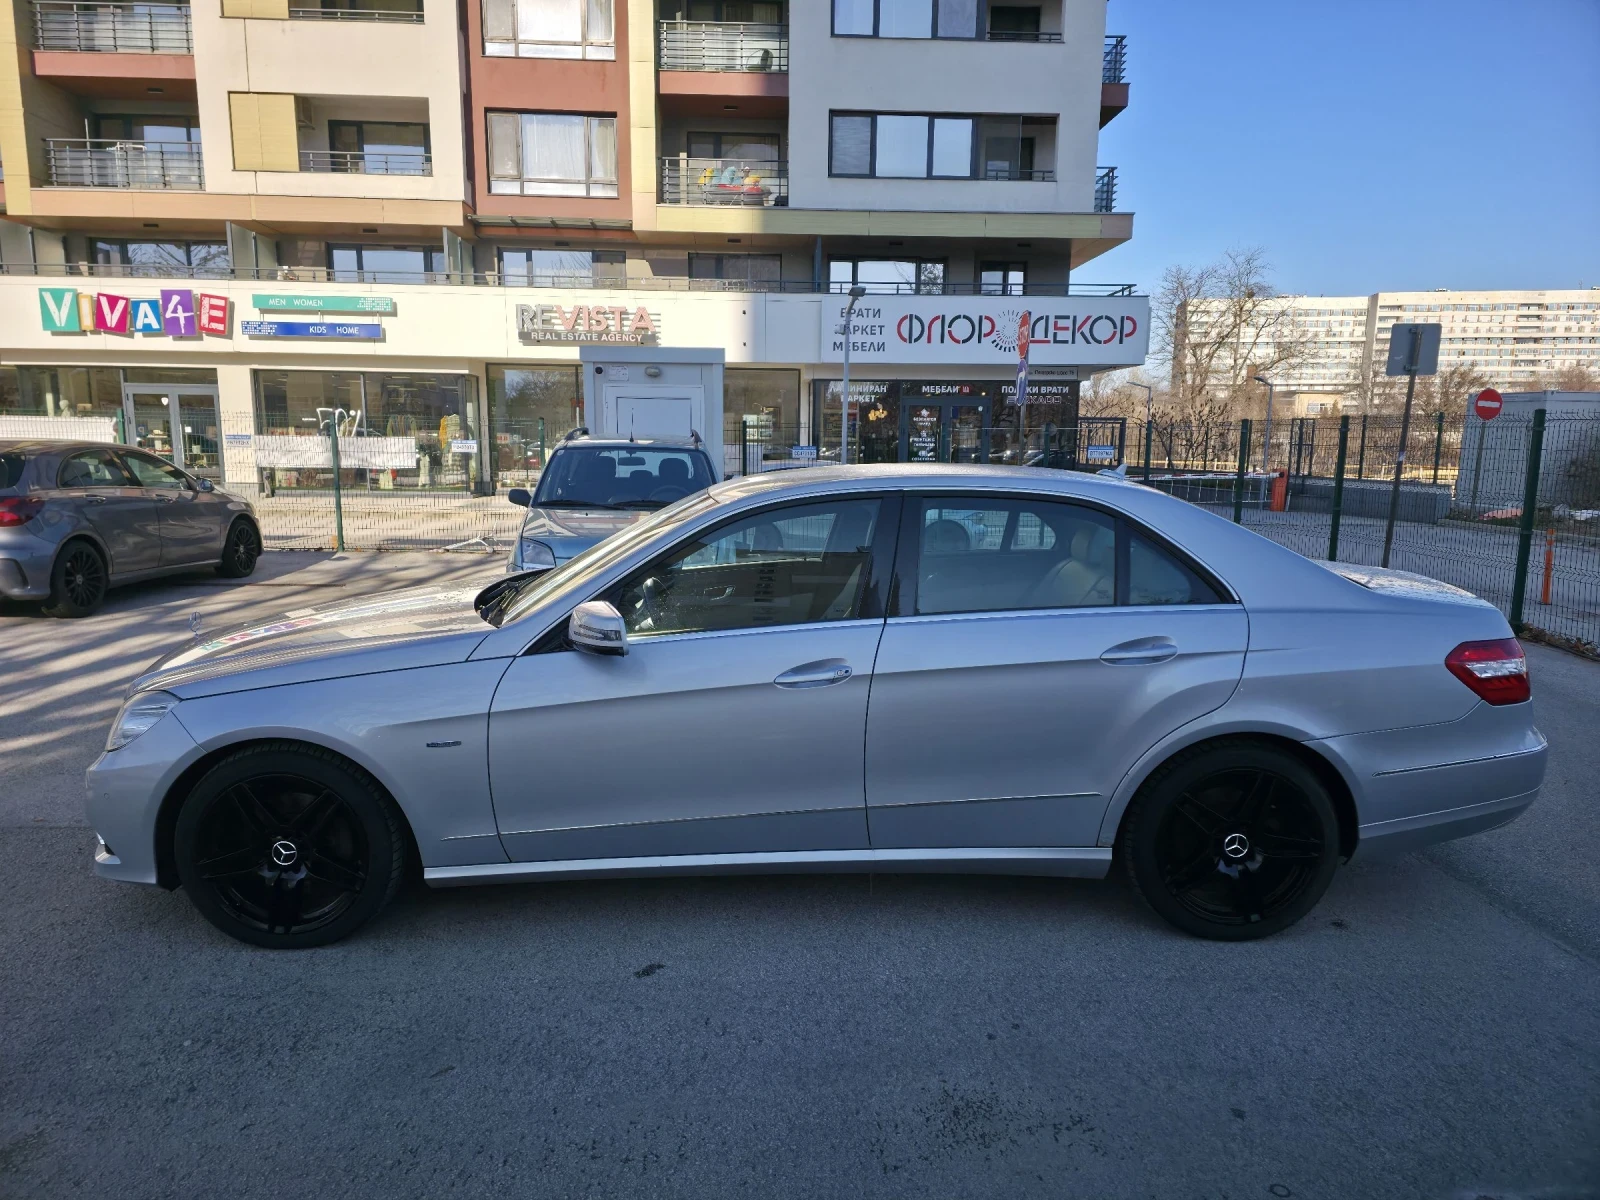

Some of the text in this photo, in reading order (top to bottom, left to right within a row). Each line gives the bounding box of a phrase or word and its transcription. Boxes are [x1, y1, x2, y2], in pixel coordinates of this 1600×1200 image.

[268, 298, 324, 307] MEN WOMEN
[515, 303, 657, 332] REVISTA
[309, 325, 360, 335] KIDS HOME
[835, 324, 885, 336] АРКЕТ
[1030, 314, 1138, 345] ДЕКОР
[531, 332, 643, 342] REAL ESTATE AGENCY
[833, 341, 886, 352] МБЕЛИ
[829, 383, 887, 393] ЛАИНИРАН
[922, 385, 959, 393] МЕБЕЛИ
[1001, 385, 1069, 394] ПОКИ ВРАТИ
